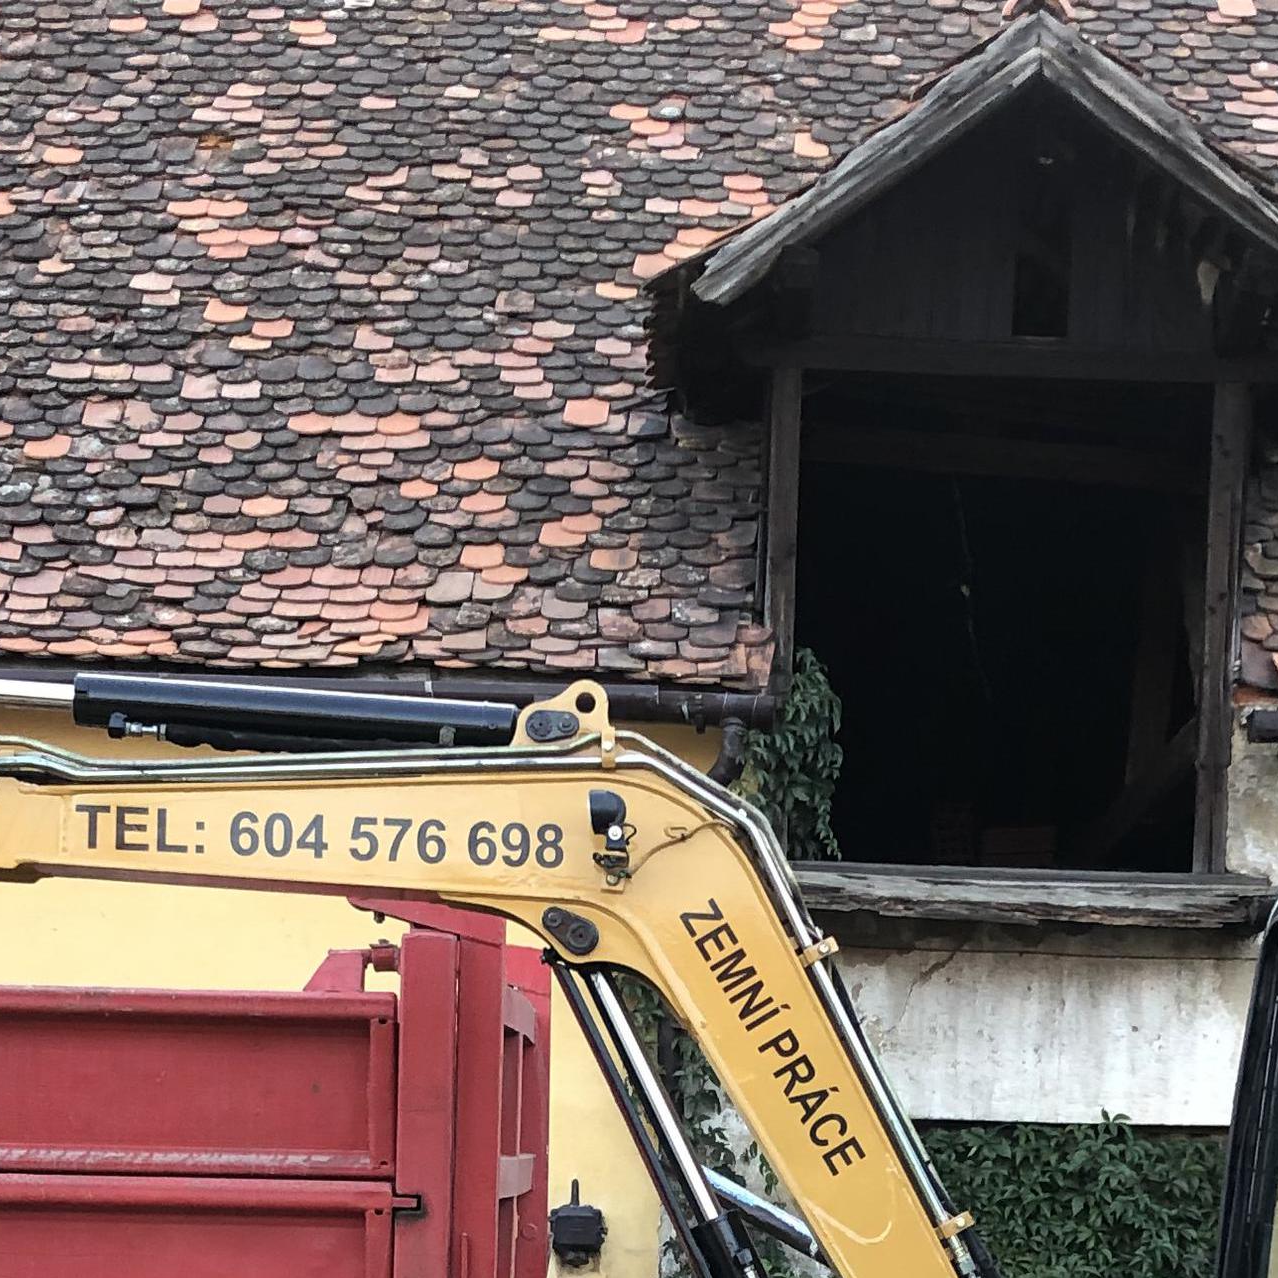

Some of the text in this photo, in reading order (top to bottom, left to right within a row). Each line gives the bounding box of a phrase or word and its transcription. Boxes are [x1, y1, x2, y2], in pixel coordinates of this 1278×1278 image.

[75, 803, 564, 868] TEL: 604 576 698
[679, 898, 866, 1176] ZEMNÍ PRÁCE
